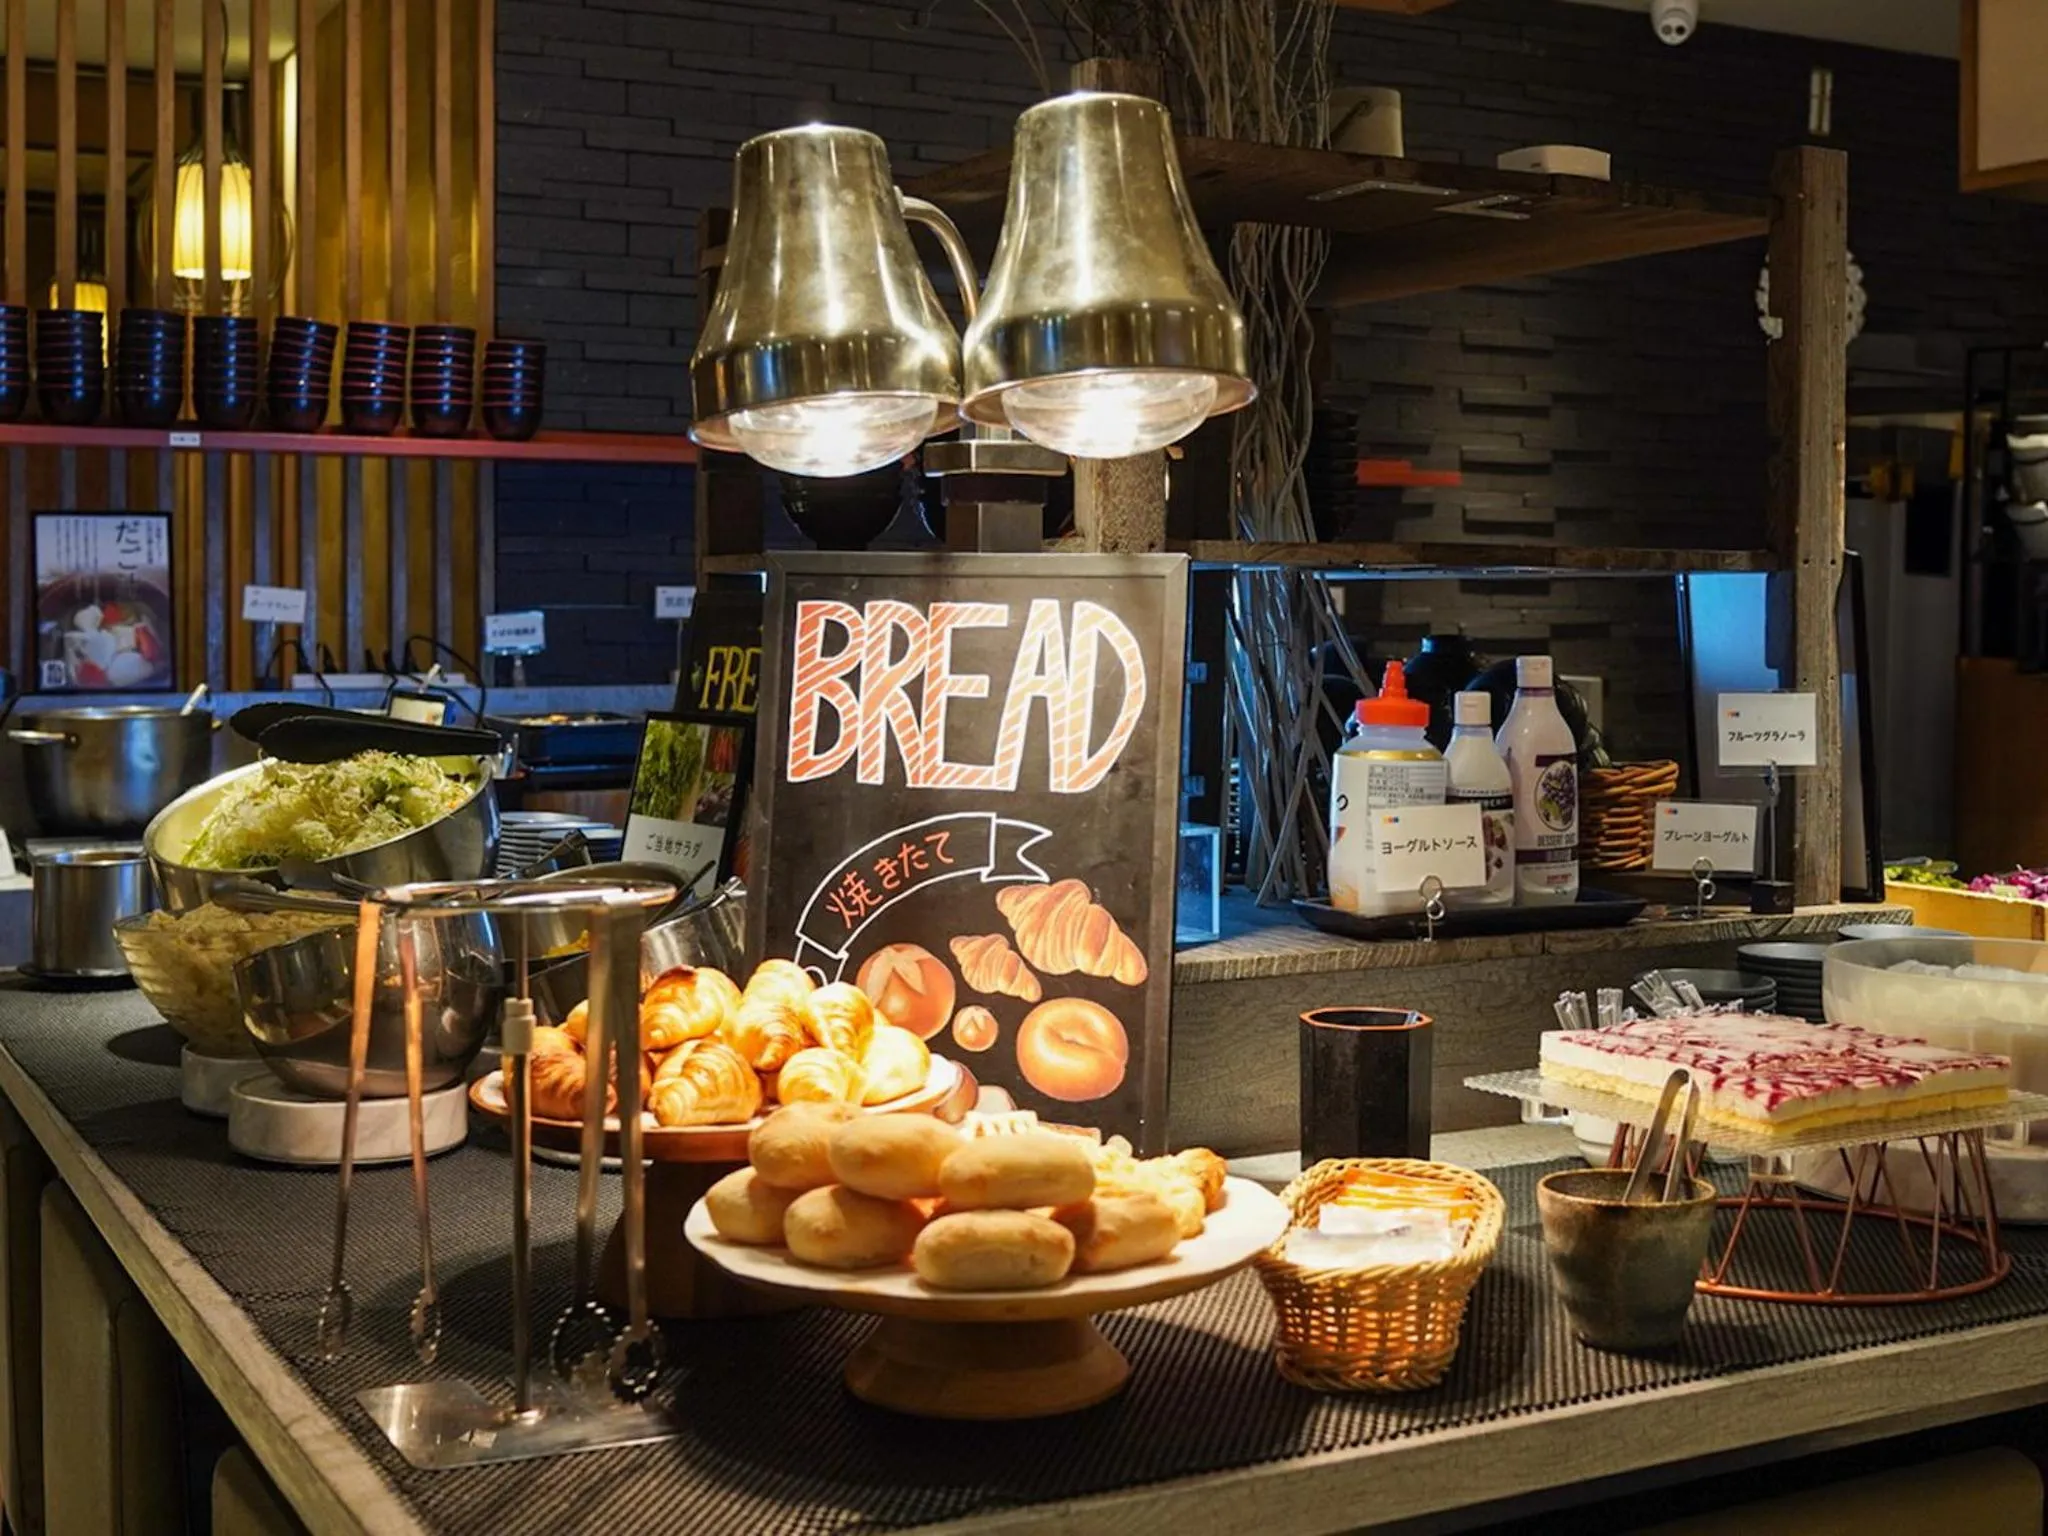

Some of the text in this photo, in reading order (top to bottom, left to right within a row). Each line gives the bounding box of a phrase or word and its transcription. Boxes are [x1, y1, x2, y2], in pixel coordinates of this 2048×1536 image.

[787, 599, 1147, 794] BREAD
[1727, 730, 1806, 742] フルーツグラノーラ
[646, 832, 704, 860] ご当地サラダ
[1381, 835, 1478, 855] ヨーグルトソース
[1663, 829, 1750, 843] プレーンヨーグルト
[825, 831, 957, 929] 焼きたて
